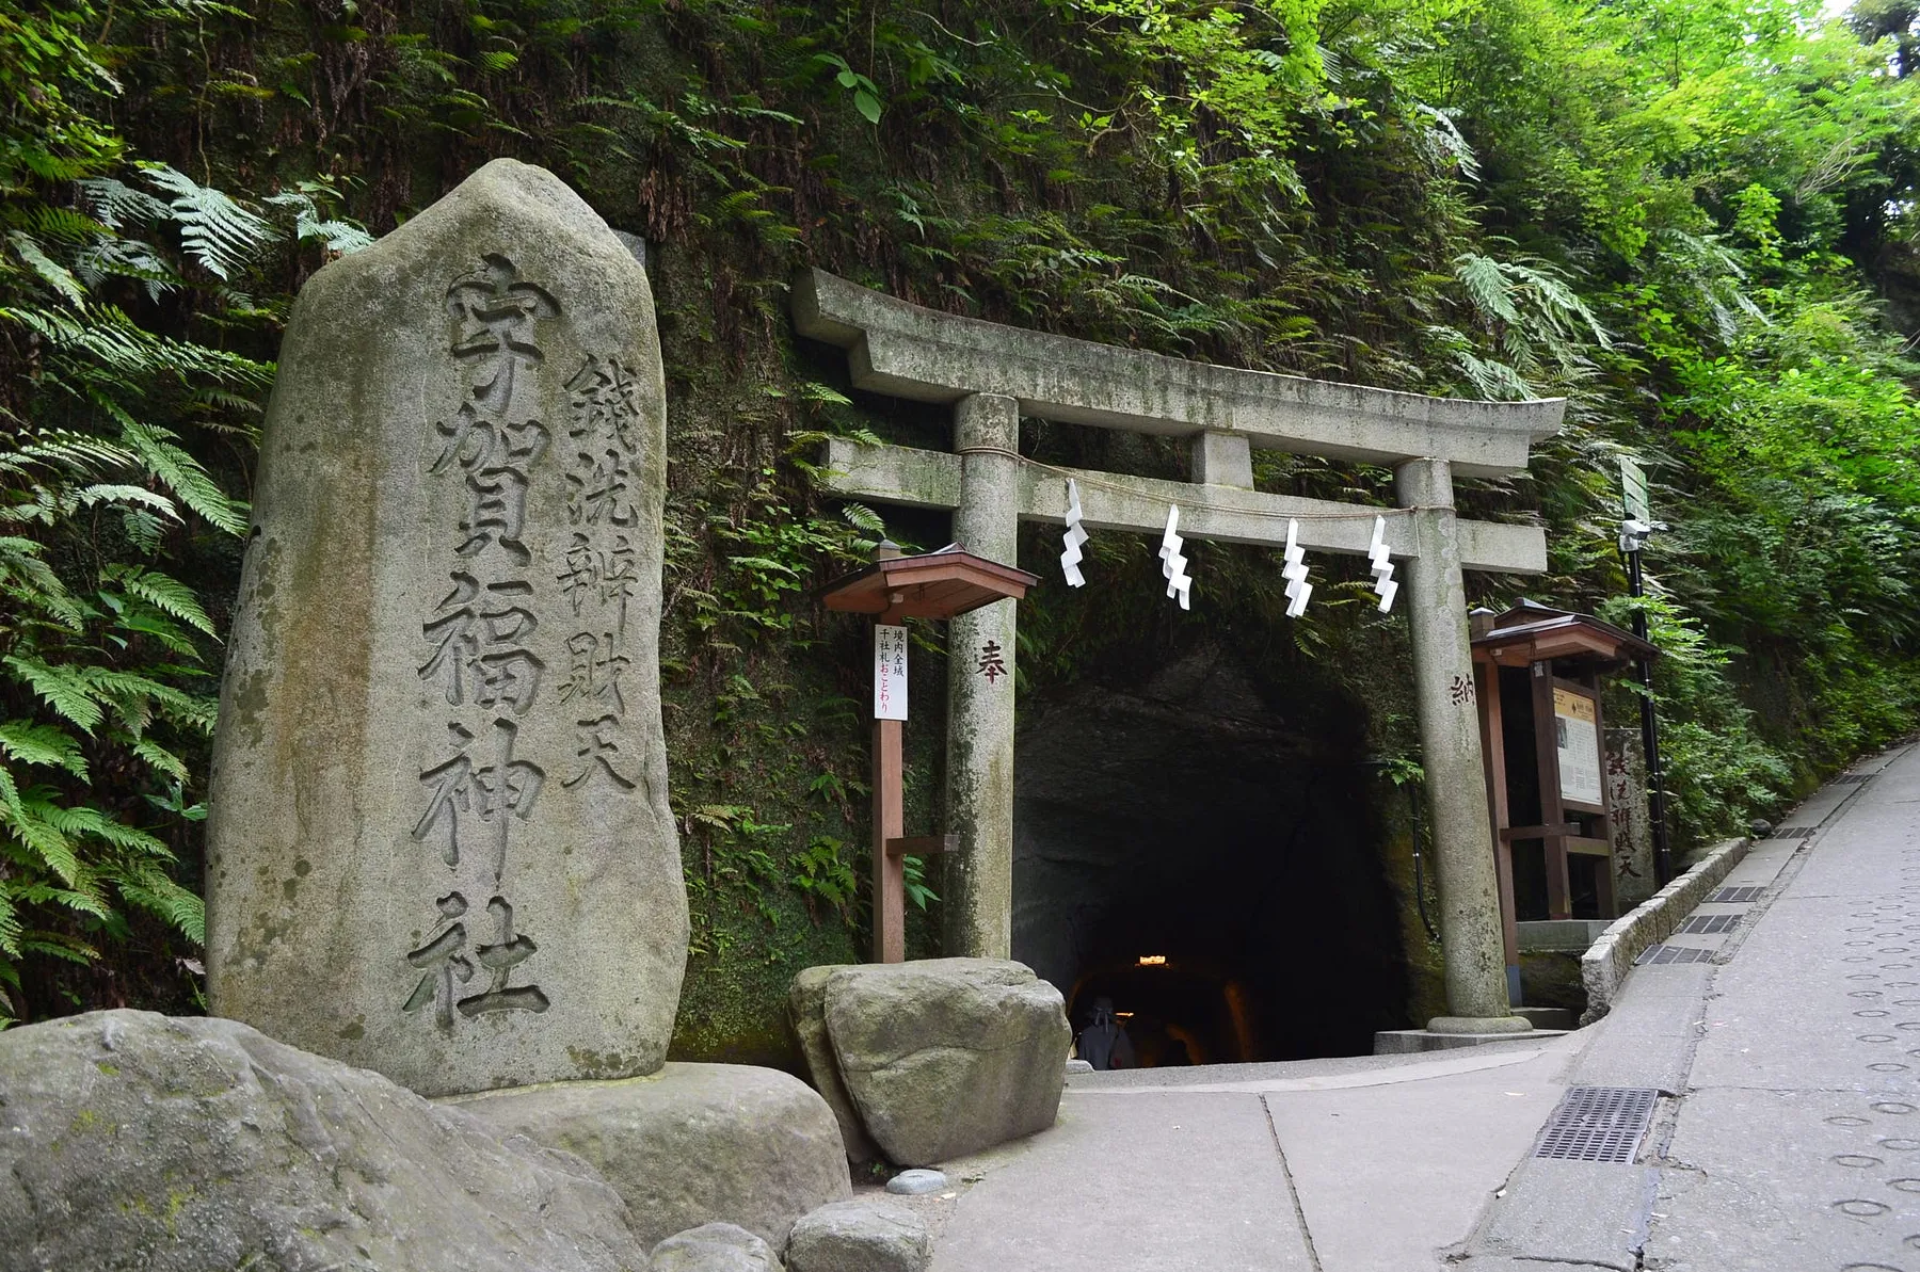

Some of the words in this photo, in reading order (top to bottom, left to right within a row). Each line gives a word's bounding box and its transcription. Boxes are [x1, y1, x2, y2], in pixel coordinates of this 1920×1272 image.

[402, 253, 562, 1027] 宇賀福神社
[894, 629, 904, 677] 境内全域
[976, 640, 1008, 684] 奉
[880, 628, 890, 713] 千社札おことわり
[1450, 673, 1475, 706] 納
